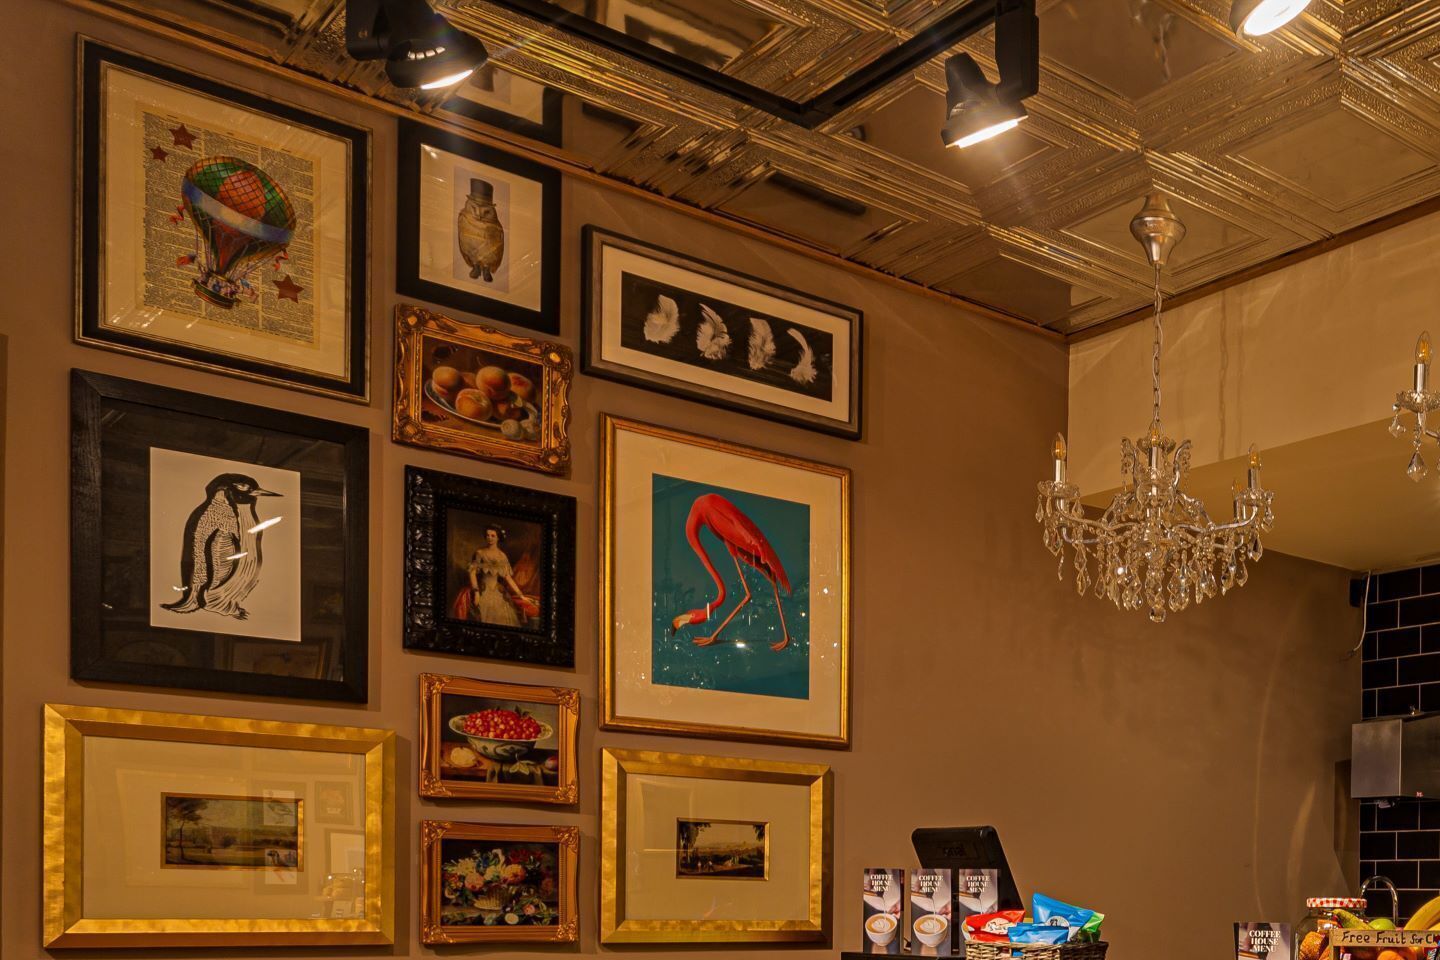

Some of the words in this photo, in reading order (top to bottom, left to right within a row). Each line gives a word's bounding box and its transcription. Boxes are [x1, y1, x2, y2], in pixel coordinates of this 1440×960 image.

[1342, 931, 1370, 943] Free
[1375, 931, 1406, 944] Fruit
[1410, 934, 1424, 944] for
[1252, 945, 1277, 953] MENU
